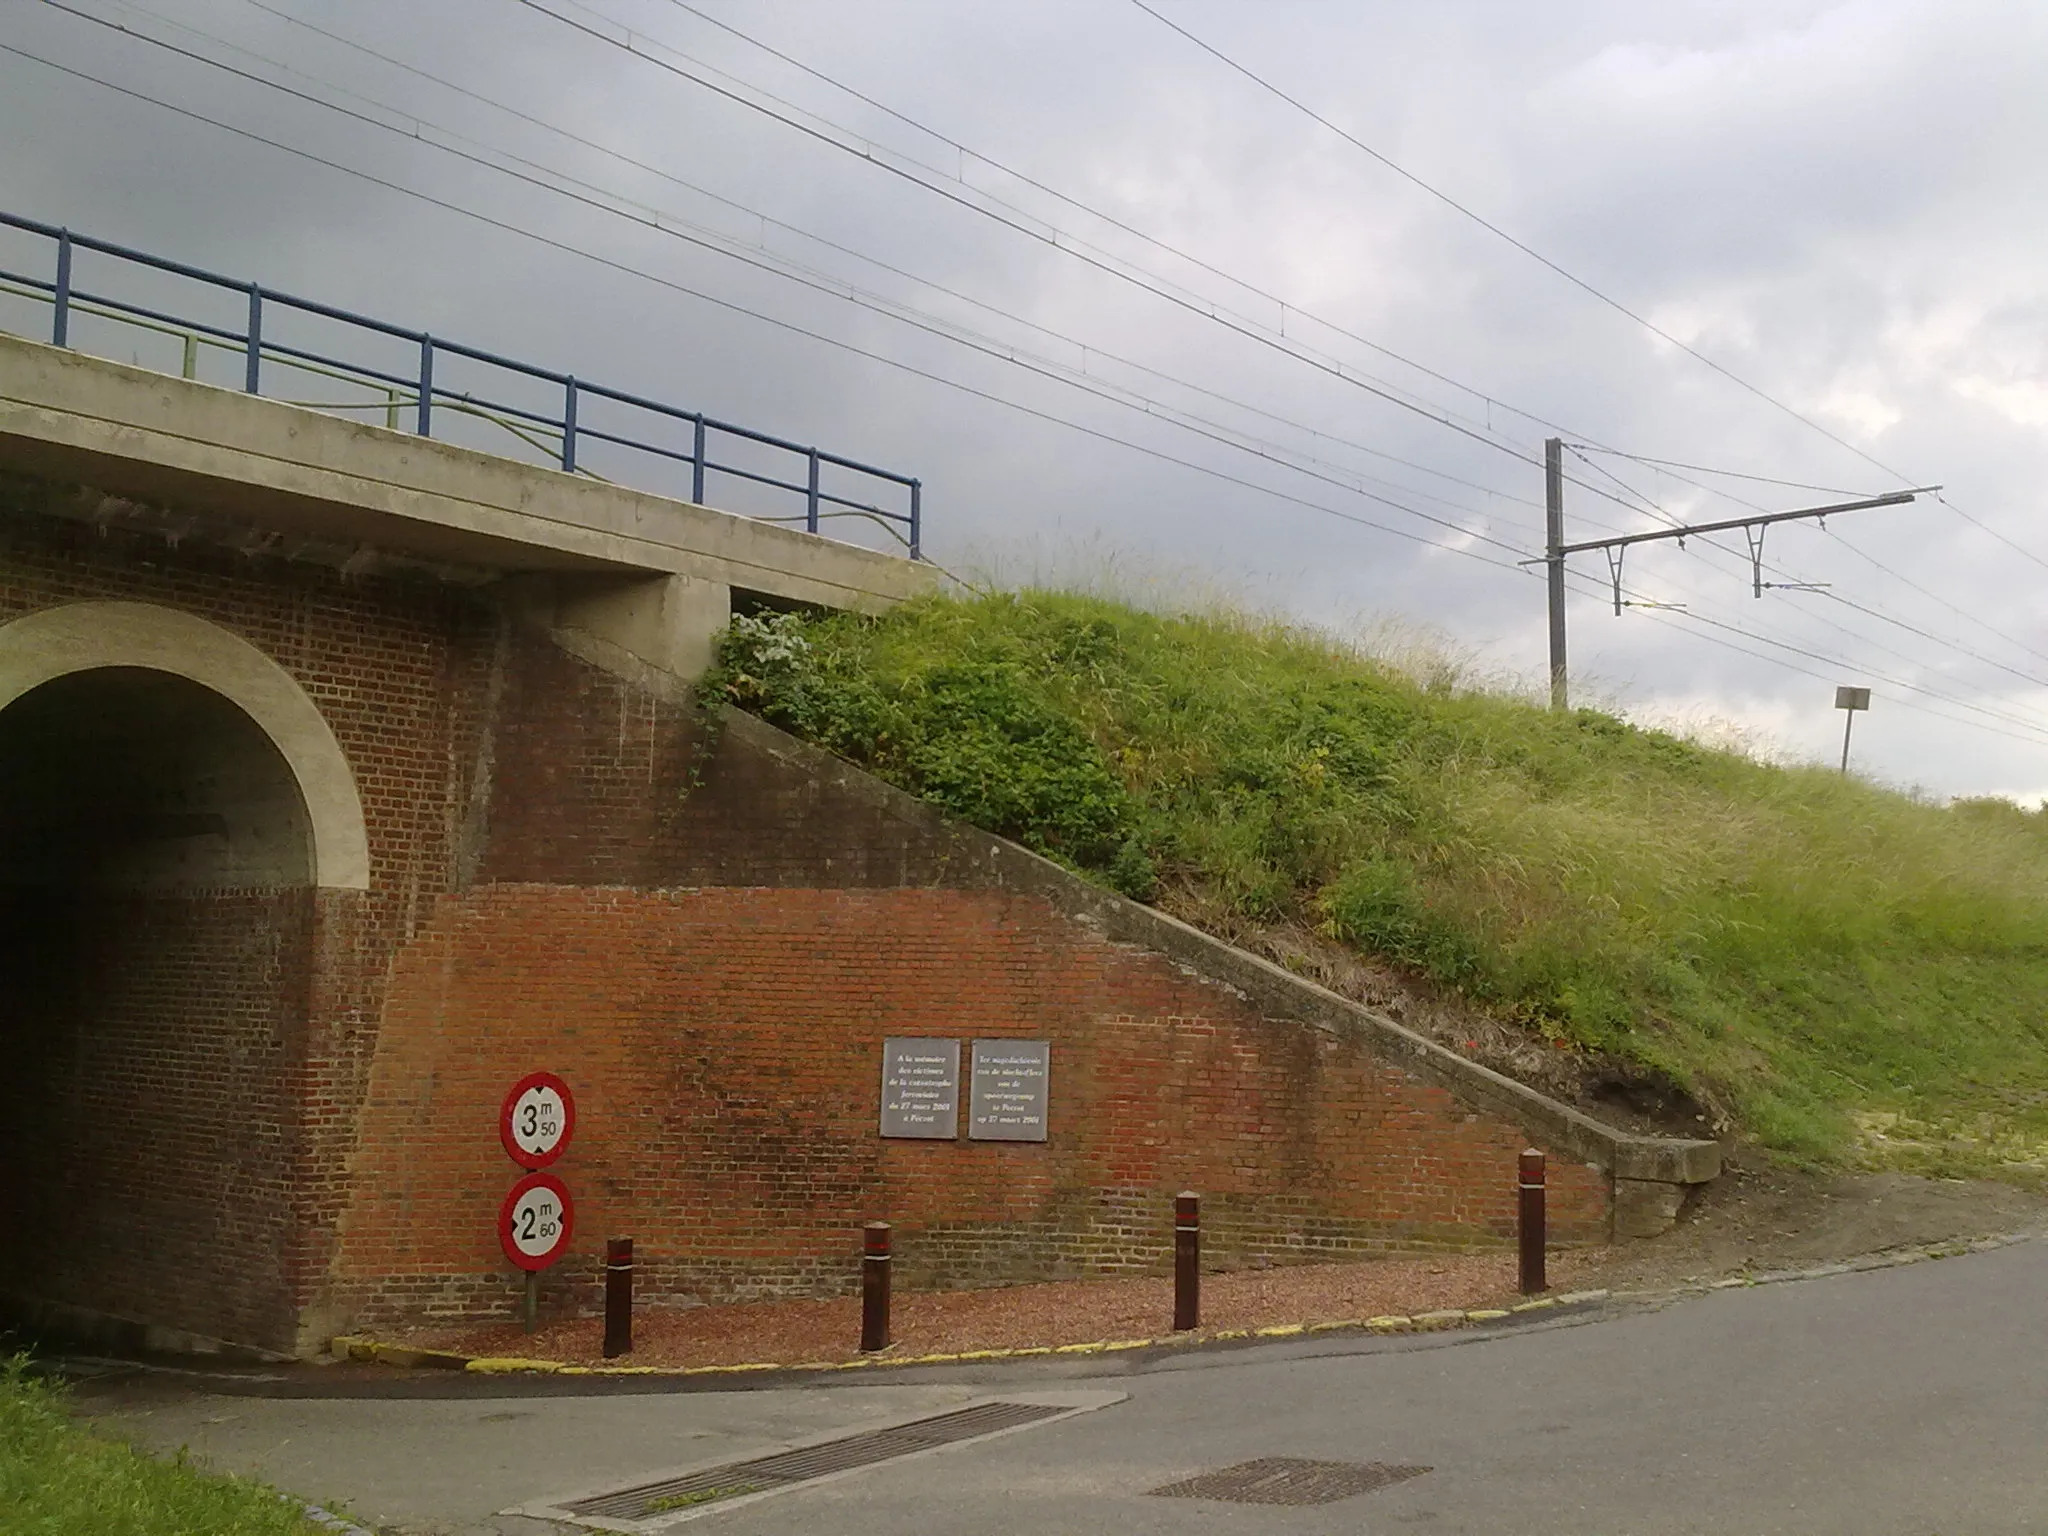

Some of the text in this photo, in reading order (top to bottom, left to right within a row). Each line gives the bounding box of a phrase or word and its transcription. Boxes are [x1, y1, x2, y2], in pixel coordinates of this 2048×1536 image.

[521, 1102, 557, 1137] 3 m 50
[521, 1203, 557, 1241] 2 m 60
